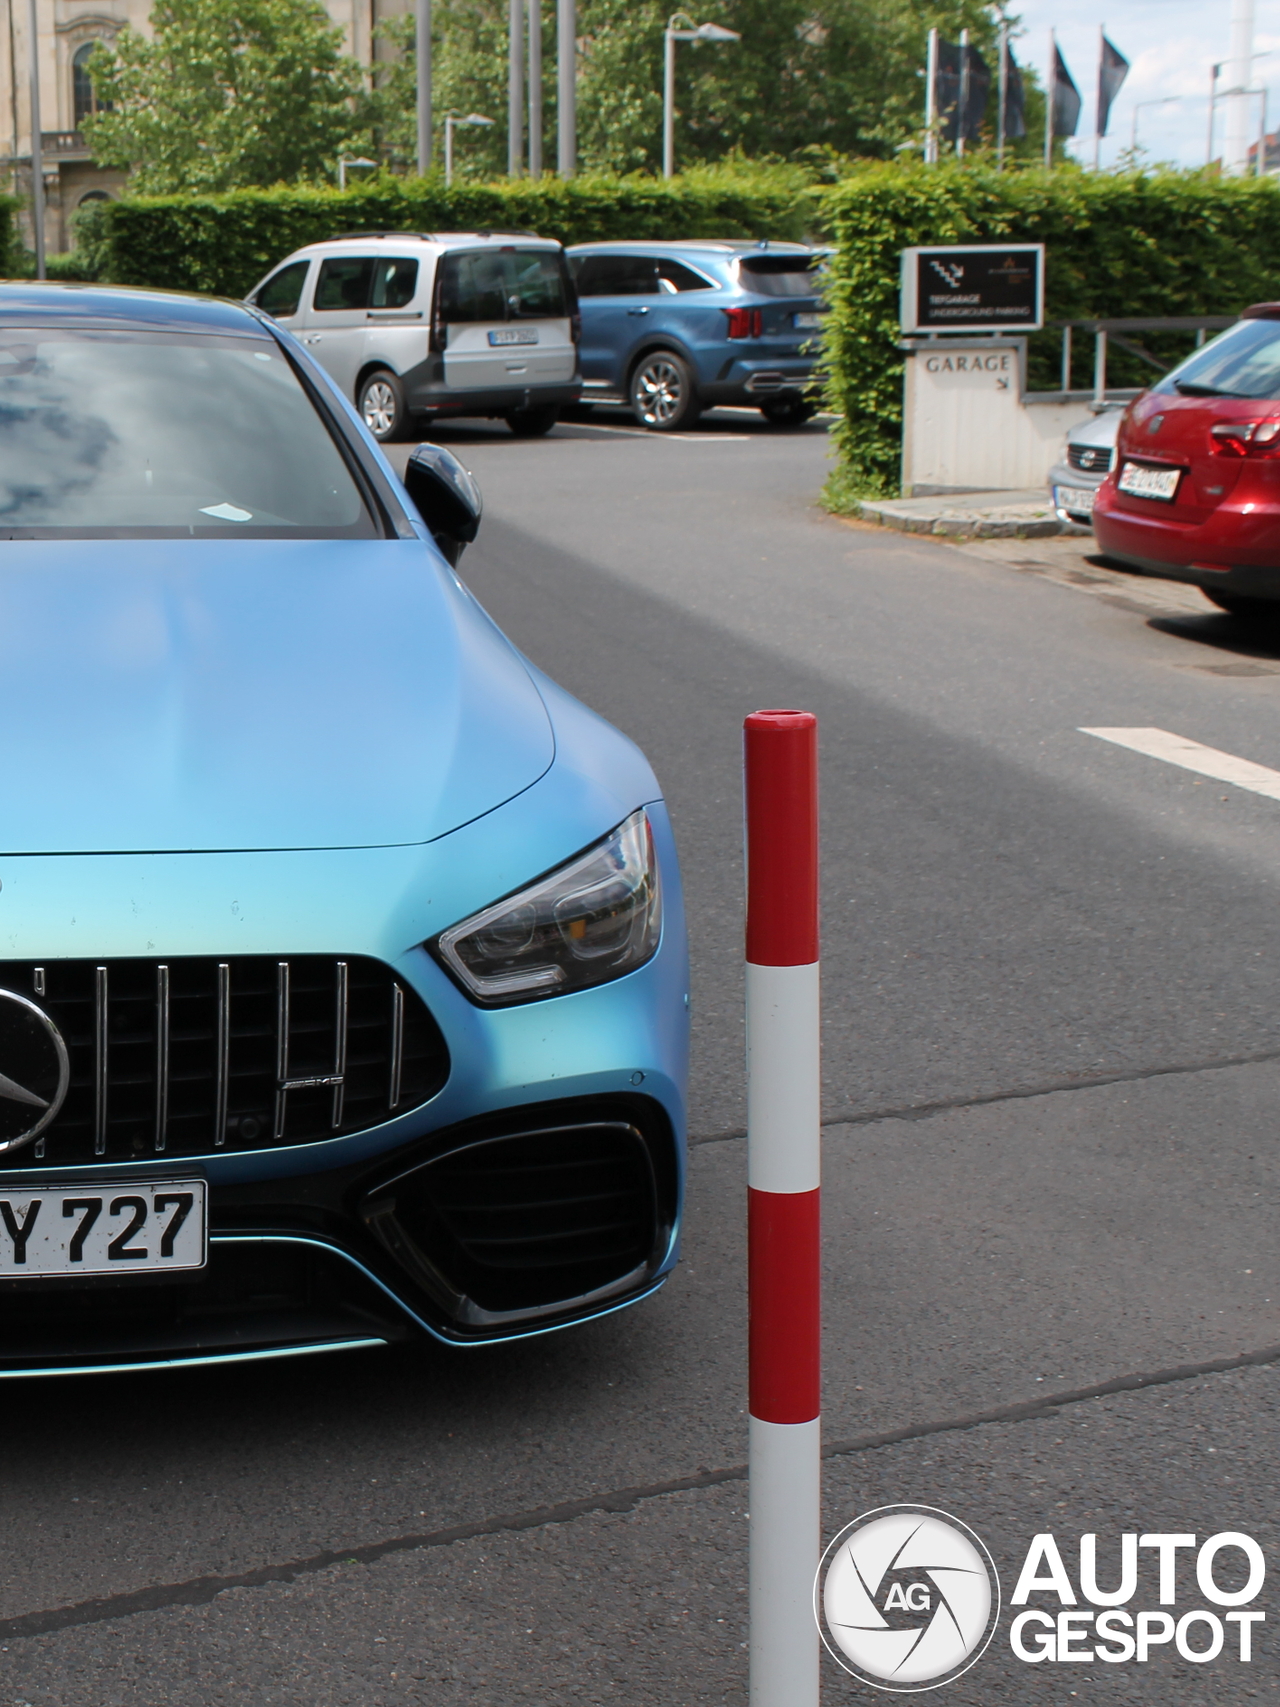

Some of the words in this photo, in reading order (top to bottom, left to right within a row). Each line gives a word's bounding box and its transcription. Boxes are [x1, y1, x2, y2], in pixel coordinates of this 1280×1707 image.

[929, 294, 980, 305] TIEFGARAGE
[929, 307, 993, 317] UNDERGROUND
[995, 306, 1030, 316] PARKING
[926, 355, 1010, 372] GARAGE
[302, 1076, 344, 1088] AMG
[62, 1192, 194, 1262] 727
